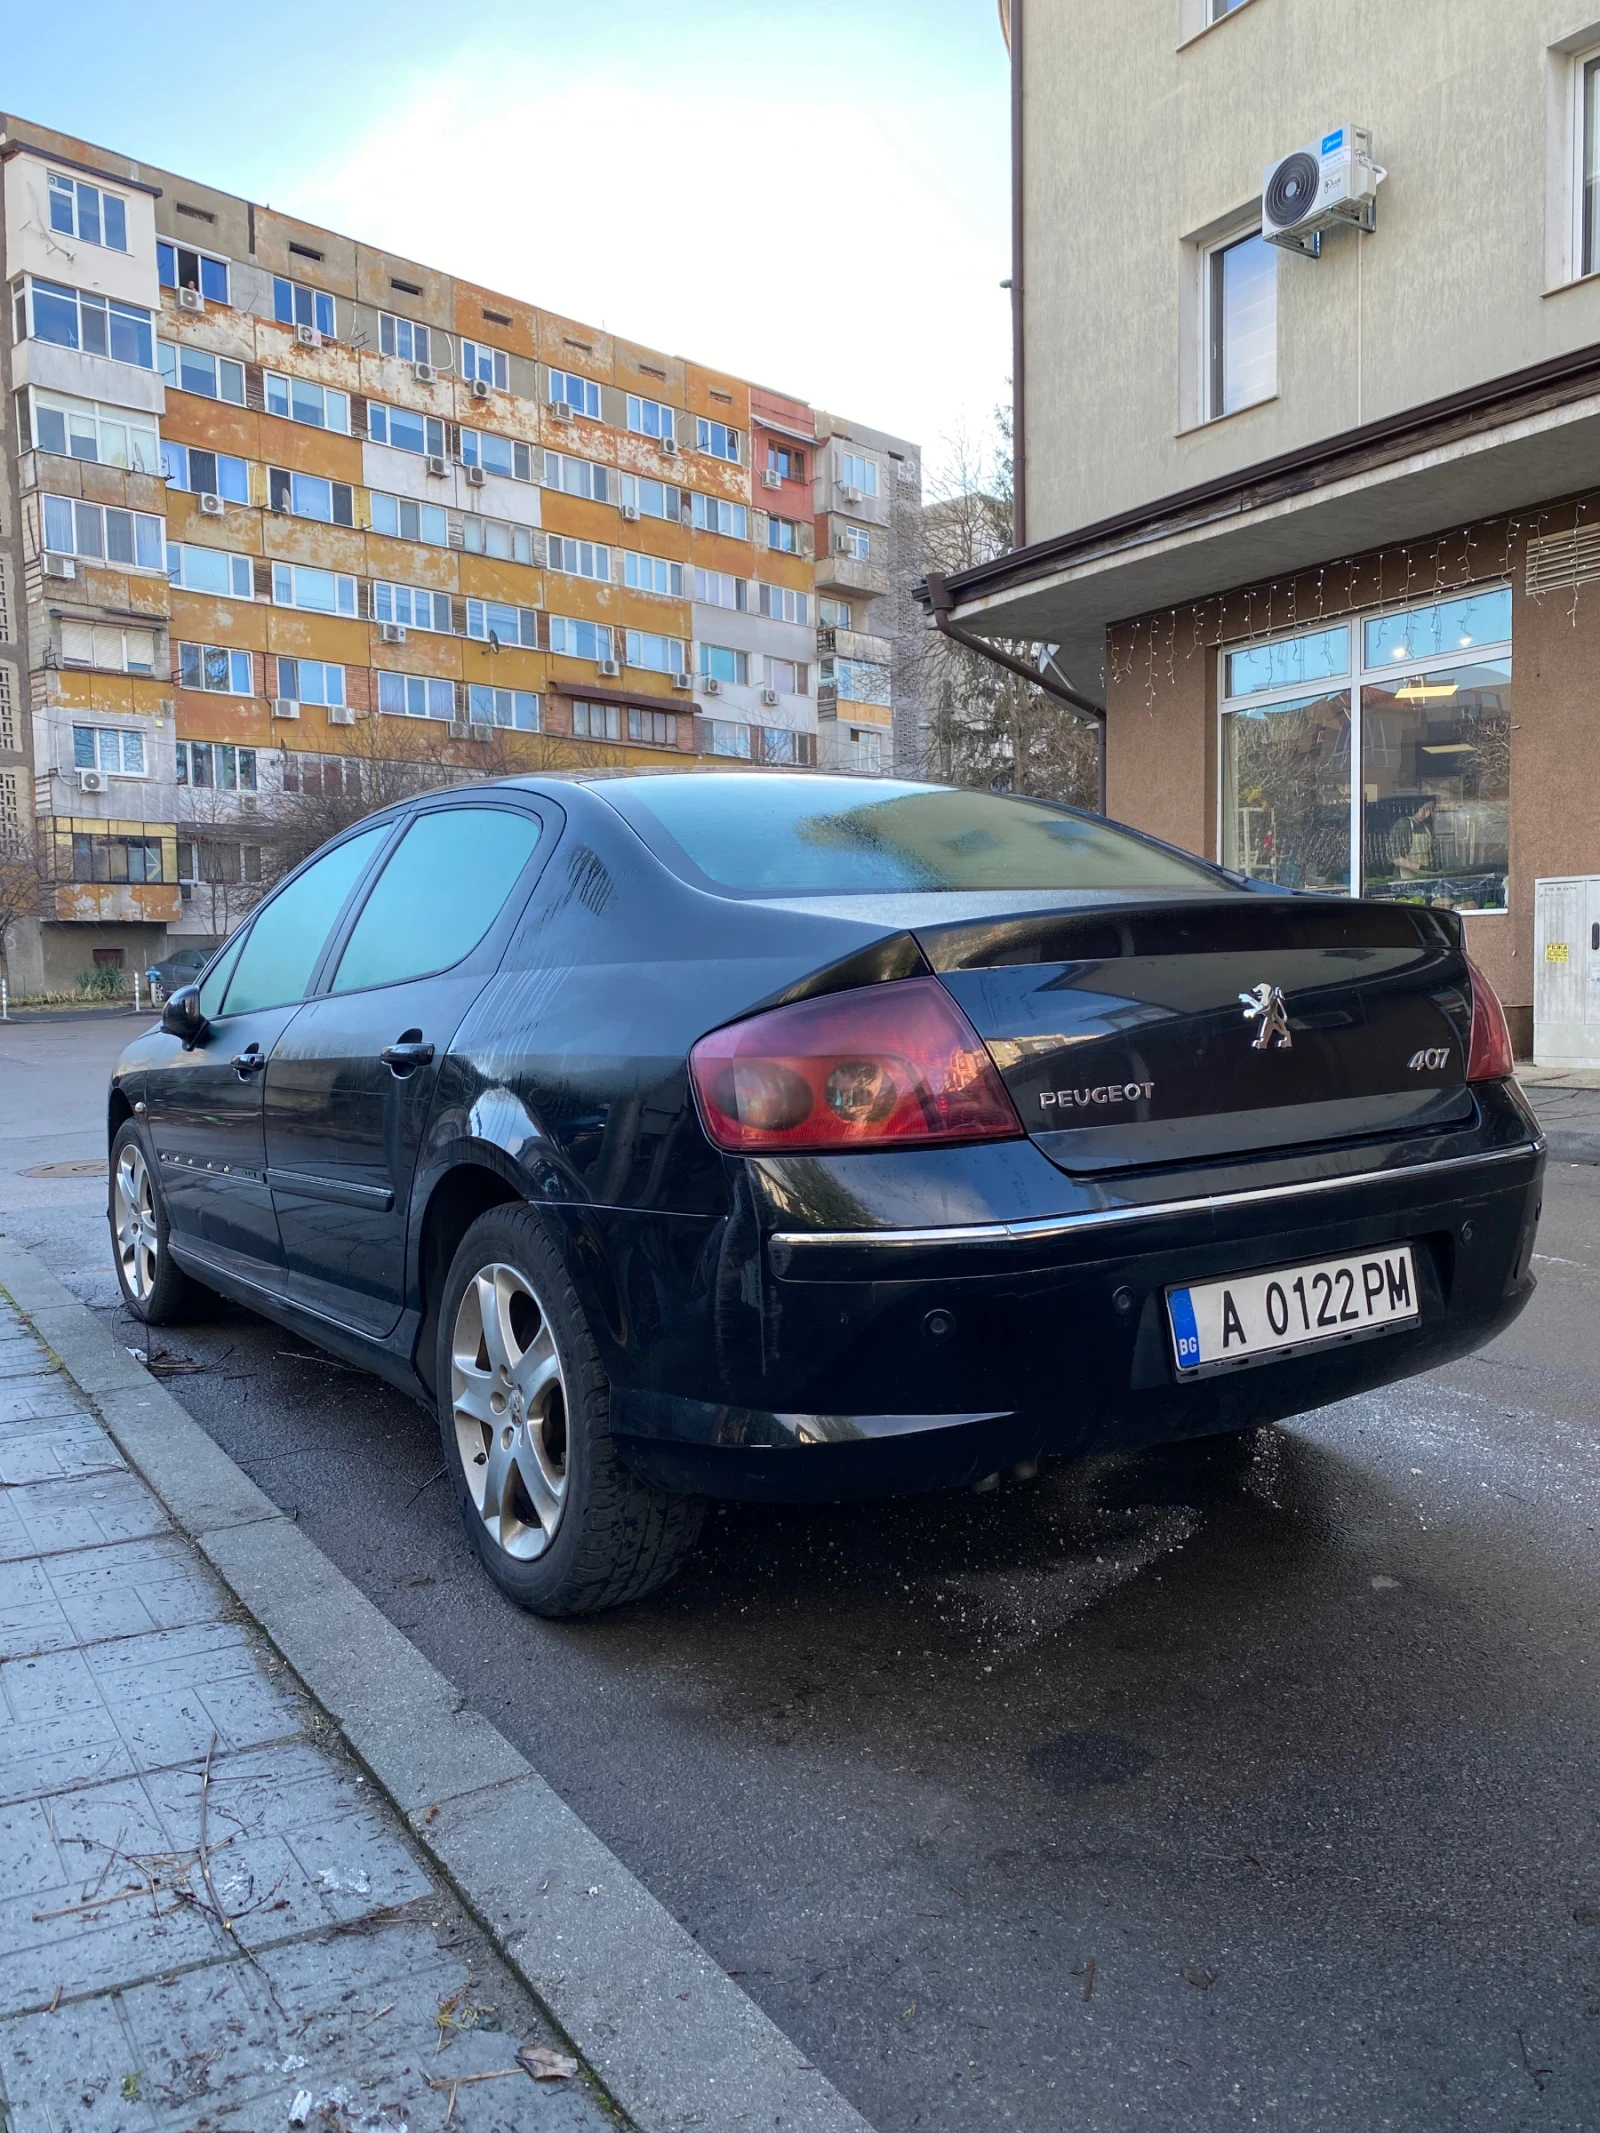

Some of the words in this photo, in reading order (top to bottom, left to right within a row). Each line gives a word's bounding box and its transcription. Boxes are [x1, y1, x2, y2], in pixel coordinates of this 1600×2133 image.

[1407, 1048, 1450, 1071] 407
[1040, 1082, 1155, 1110] PEUGEOT
[1222, 1290, 1247, 1348] A
[1179, 1337, 1198, 1356] BG
